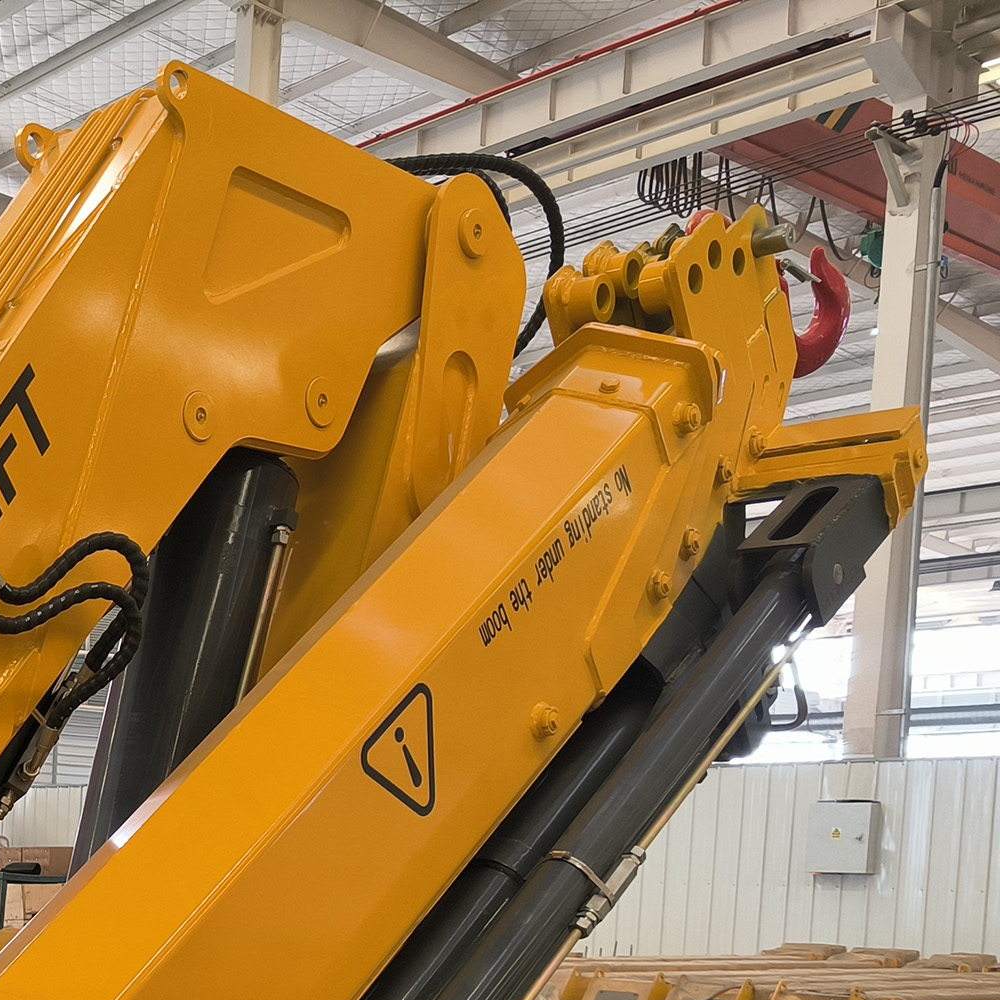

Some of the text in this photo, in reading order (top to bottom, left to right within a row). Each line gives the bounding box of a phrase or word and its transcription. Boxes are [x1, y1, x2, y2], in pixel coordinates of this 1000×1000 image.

[478, 464, 632, 647] No standing under the boom
